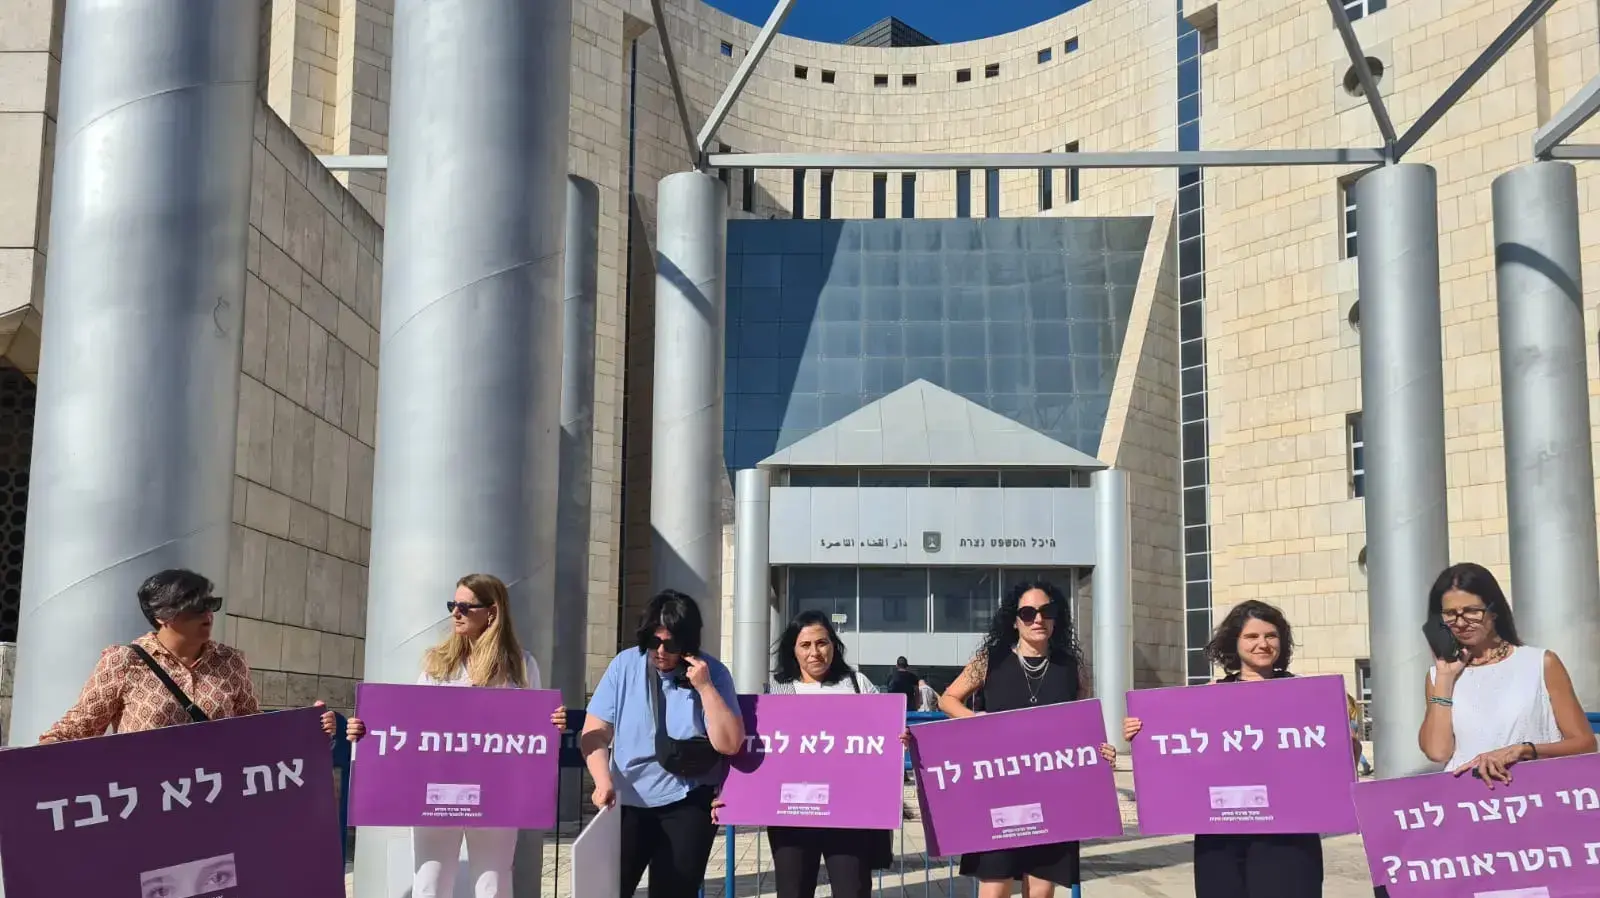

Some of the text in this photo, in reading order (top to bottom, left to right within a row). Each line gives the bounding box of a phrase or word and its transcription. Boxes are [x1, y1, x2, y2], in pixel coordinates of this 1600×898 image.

[959, 538, 985, 548] נצרת
[1032, 536, 1057, 548] היכל
[370, 725, 407, 756] לך
[418, 731, 547, 755] מאמינות
[745, 730, 885, 755] את לא לבד
[1151, 724, 1326, 755] את לא לבד
[927, 745, 1098, 790] מאמינות לך
[36, 758, 304, 832] את לא לבד
[1394, 787, 1600, 830] מי יקצר לנו
[1382, 846, 1572, 884] הטראומה?
